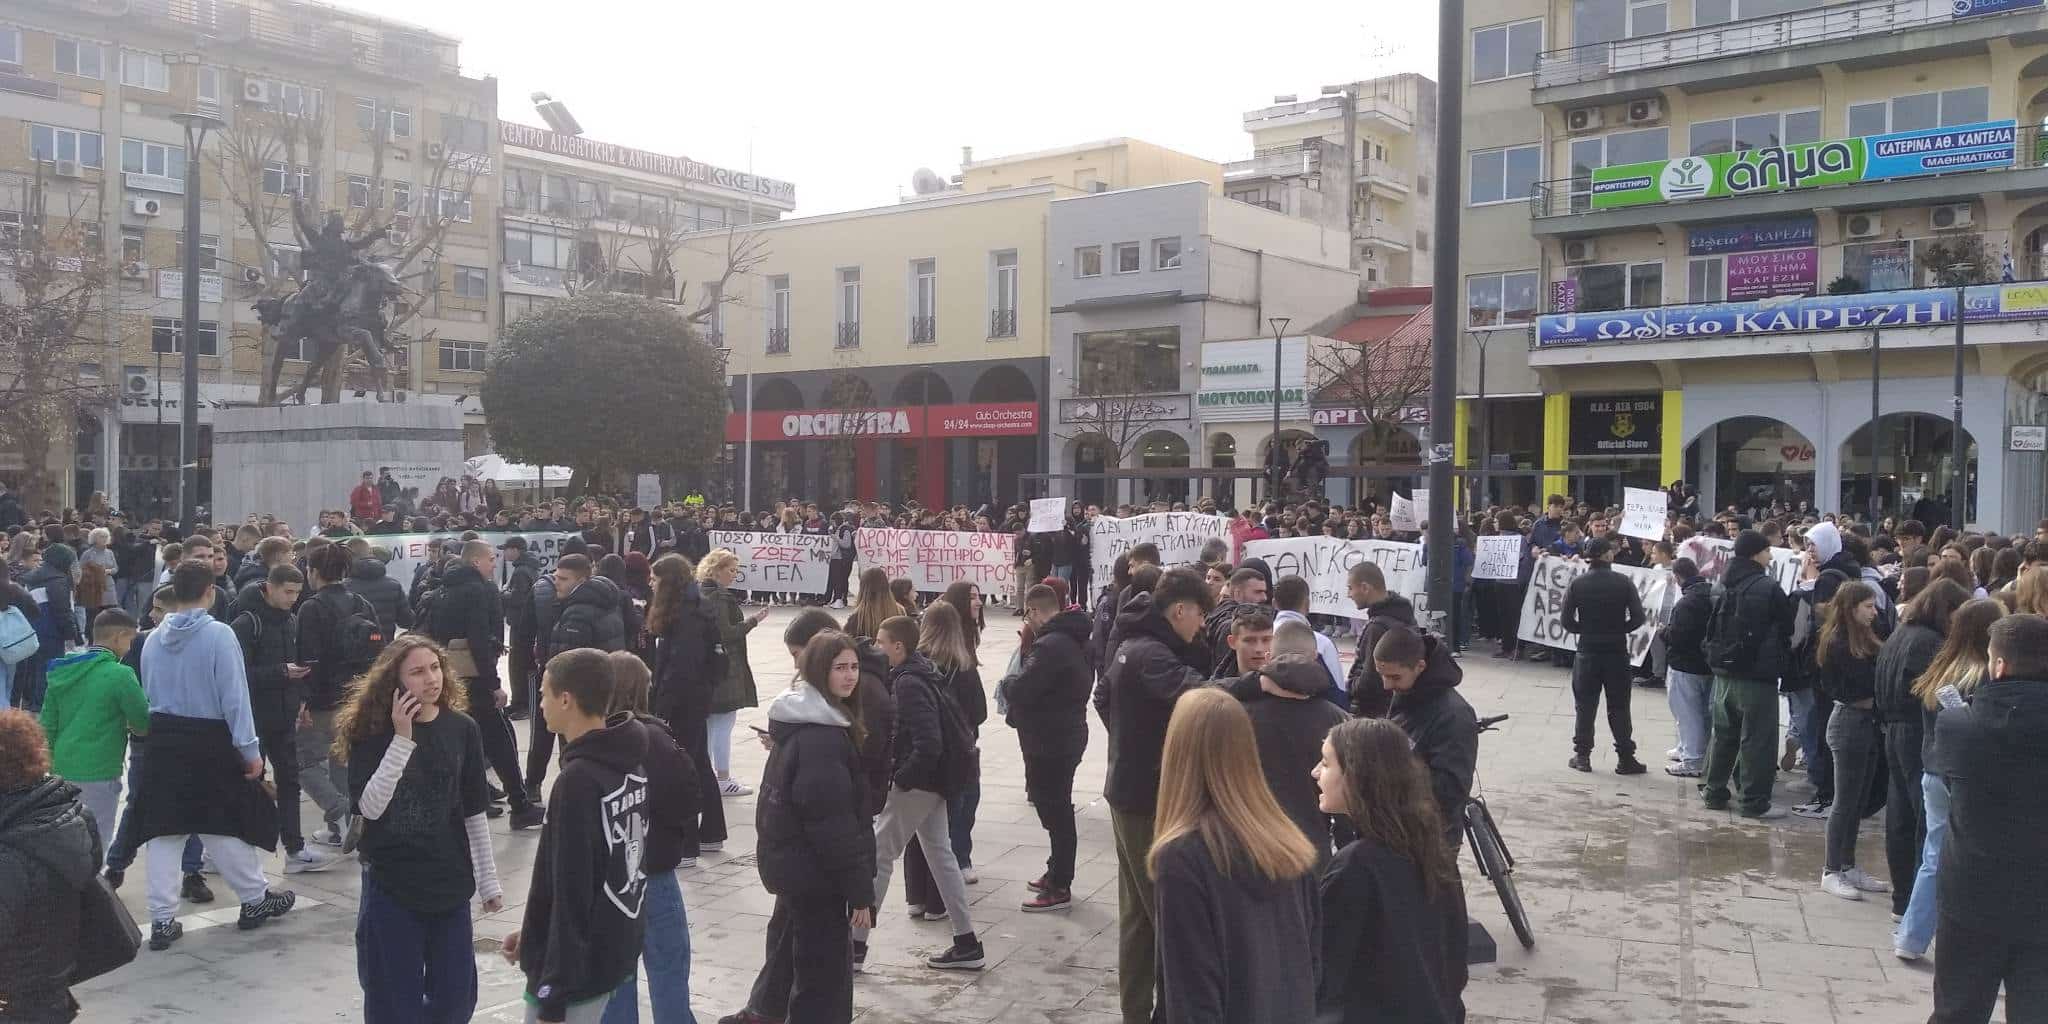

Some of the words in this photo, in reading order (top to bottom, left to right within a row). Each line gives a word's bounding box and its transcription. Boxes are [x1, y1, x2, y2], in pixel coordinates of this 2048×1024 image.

[500, 121, 544, 148] ΚΕΝΤΡΟ
[1879, 138, 1932, 156] ΚΑΤΕΡΙΝΑ
[1935, 137, 1955, 149] ΑΘ.
[1957, 130, 2012, 146] ΚΑΝΤΕΛΑ
[1726, 143, 1851, 191] άλμα
[1926, 150, 2009, 167] ΜΑΘΗΜΑΤΙΚΟΣ
[1594, 179, 1651, 192] ΦΡΟΝΤΙΣΤΗΡΙΟ
[1596, 311, 1723, 341] Ωδείο
[1733, 301, 1945, 334] ΚΑΡΕΖΗ
[782, 410, 912, 437] ORCHESTRA
[713, 532, 753, 545] ΠΟΣΟ
[760, 534, 830, 547] ΚΟΣΤΙΖΟΥΝ
[857, 528, 959, 549] ΔΡΟΜΟΛΟΓΙΟ
[969, 533, 1016, 549] ΘΑΝΑΤ
[887, 549, 909, 562] ΜΕ
[764, 564, 804, 582] ΓΕΛ
[926, 563, 1016, 583] ΕΠΙΣΤΡΟΦ
